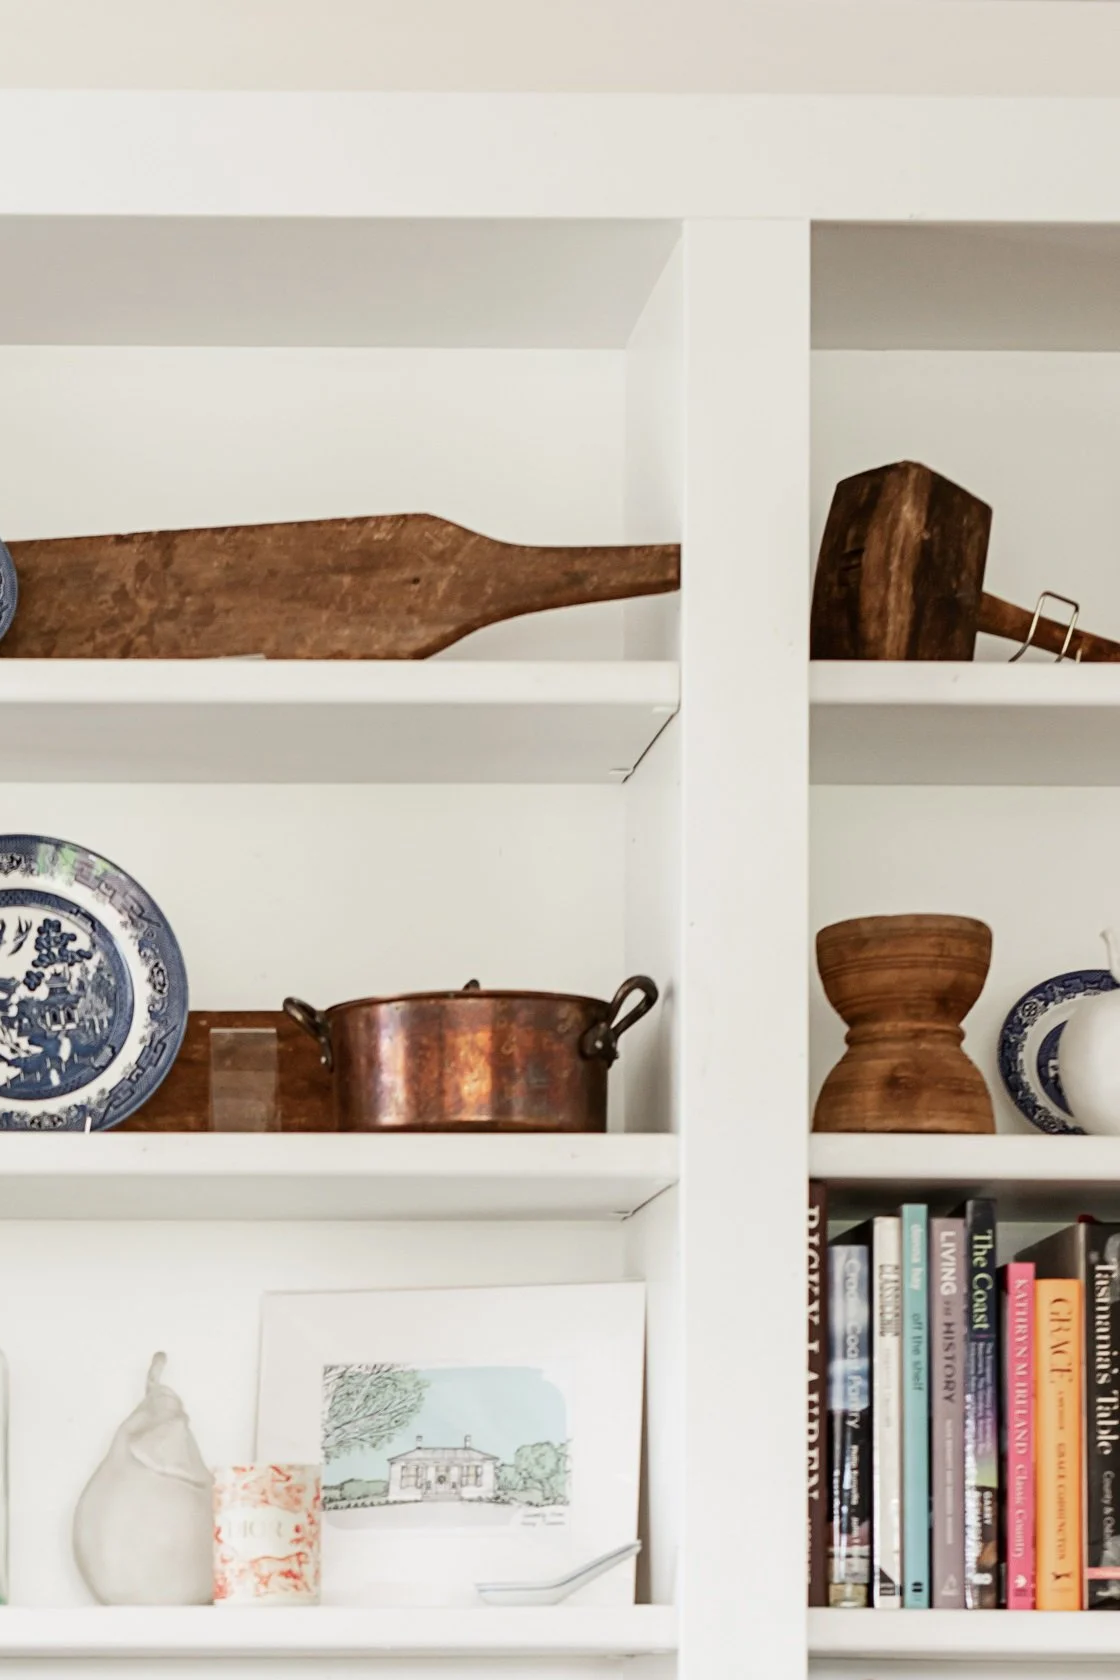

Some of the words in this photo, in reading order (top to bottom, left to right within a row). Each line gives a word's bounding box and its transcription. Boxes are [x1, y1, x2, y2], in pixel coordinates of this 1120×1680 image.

[908, 1267, 924, 1290] hay
[940, 1231, 957, 1295] LIVING
[972, 1229, 994, 1268] The
[911, 1313, 924, 1331] off
[971, 1272, 993, 1331] Coast
[1015, 1278, 1030, 1357] KATHRYN
[1094, 1263, 1119, 1385] Tasmania's
[911, 1336, 924, 1355] the
[942, 1322, 957, 1404] HISTORY
[1049, 1297, 1073, 1384] GRACE
[911, 1360, 924, 1391] shelf
[1015, 1382, 1030, 1454] IRELAND
[1094, 1390, 1119, 1455] Table
[1014, 1464, 1028, 1505] Classic
[1011, 1509, 1027, 1558] Country
[1057, 1484, 1067, 1561] CODDINGTON
